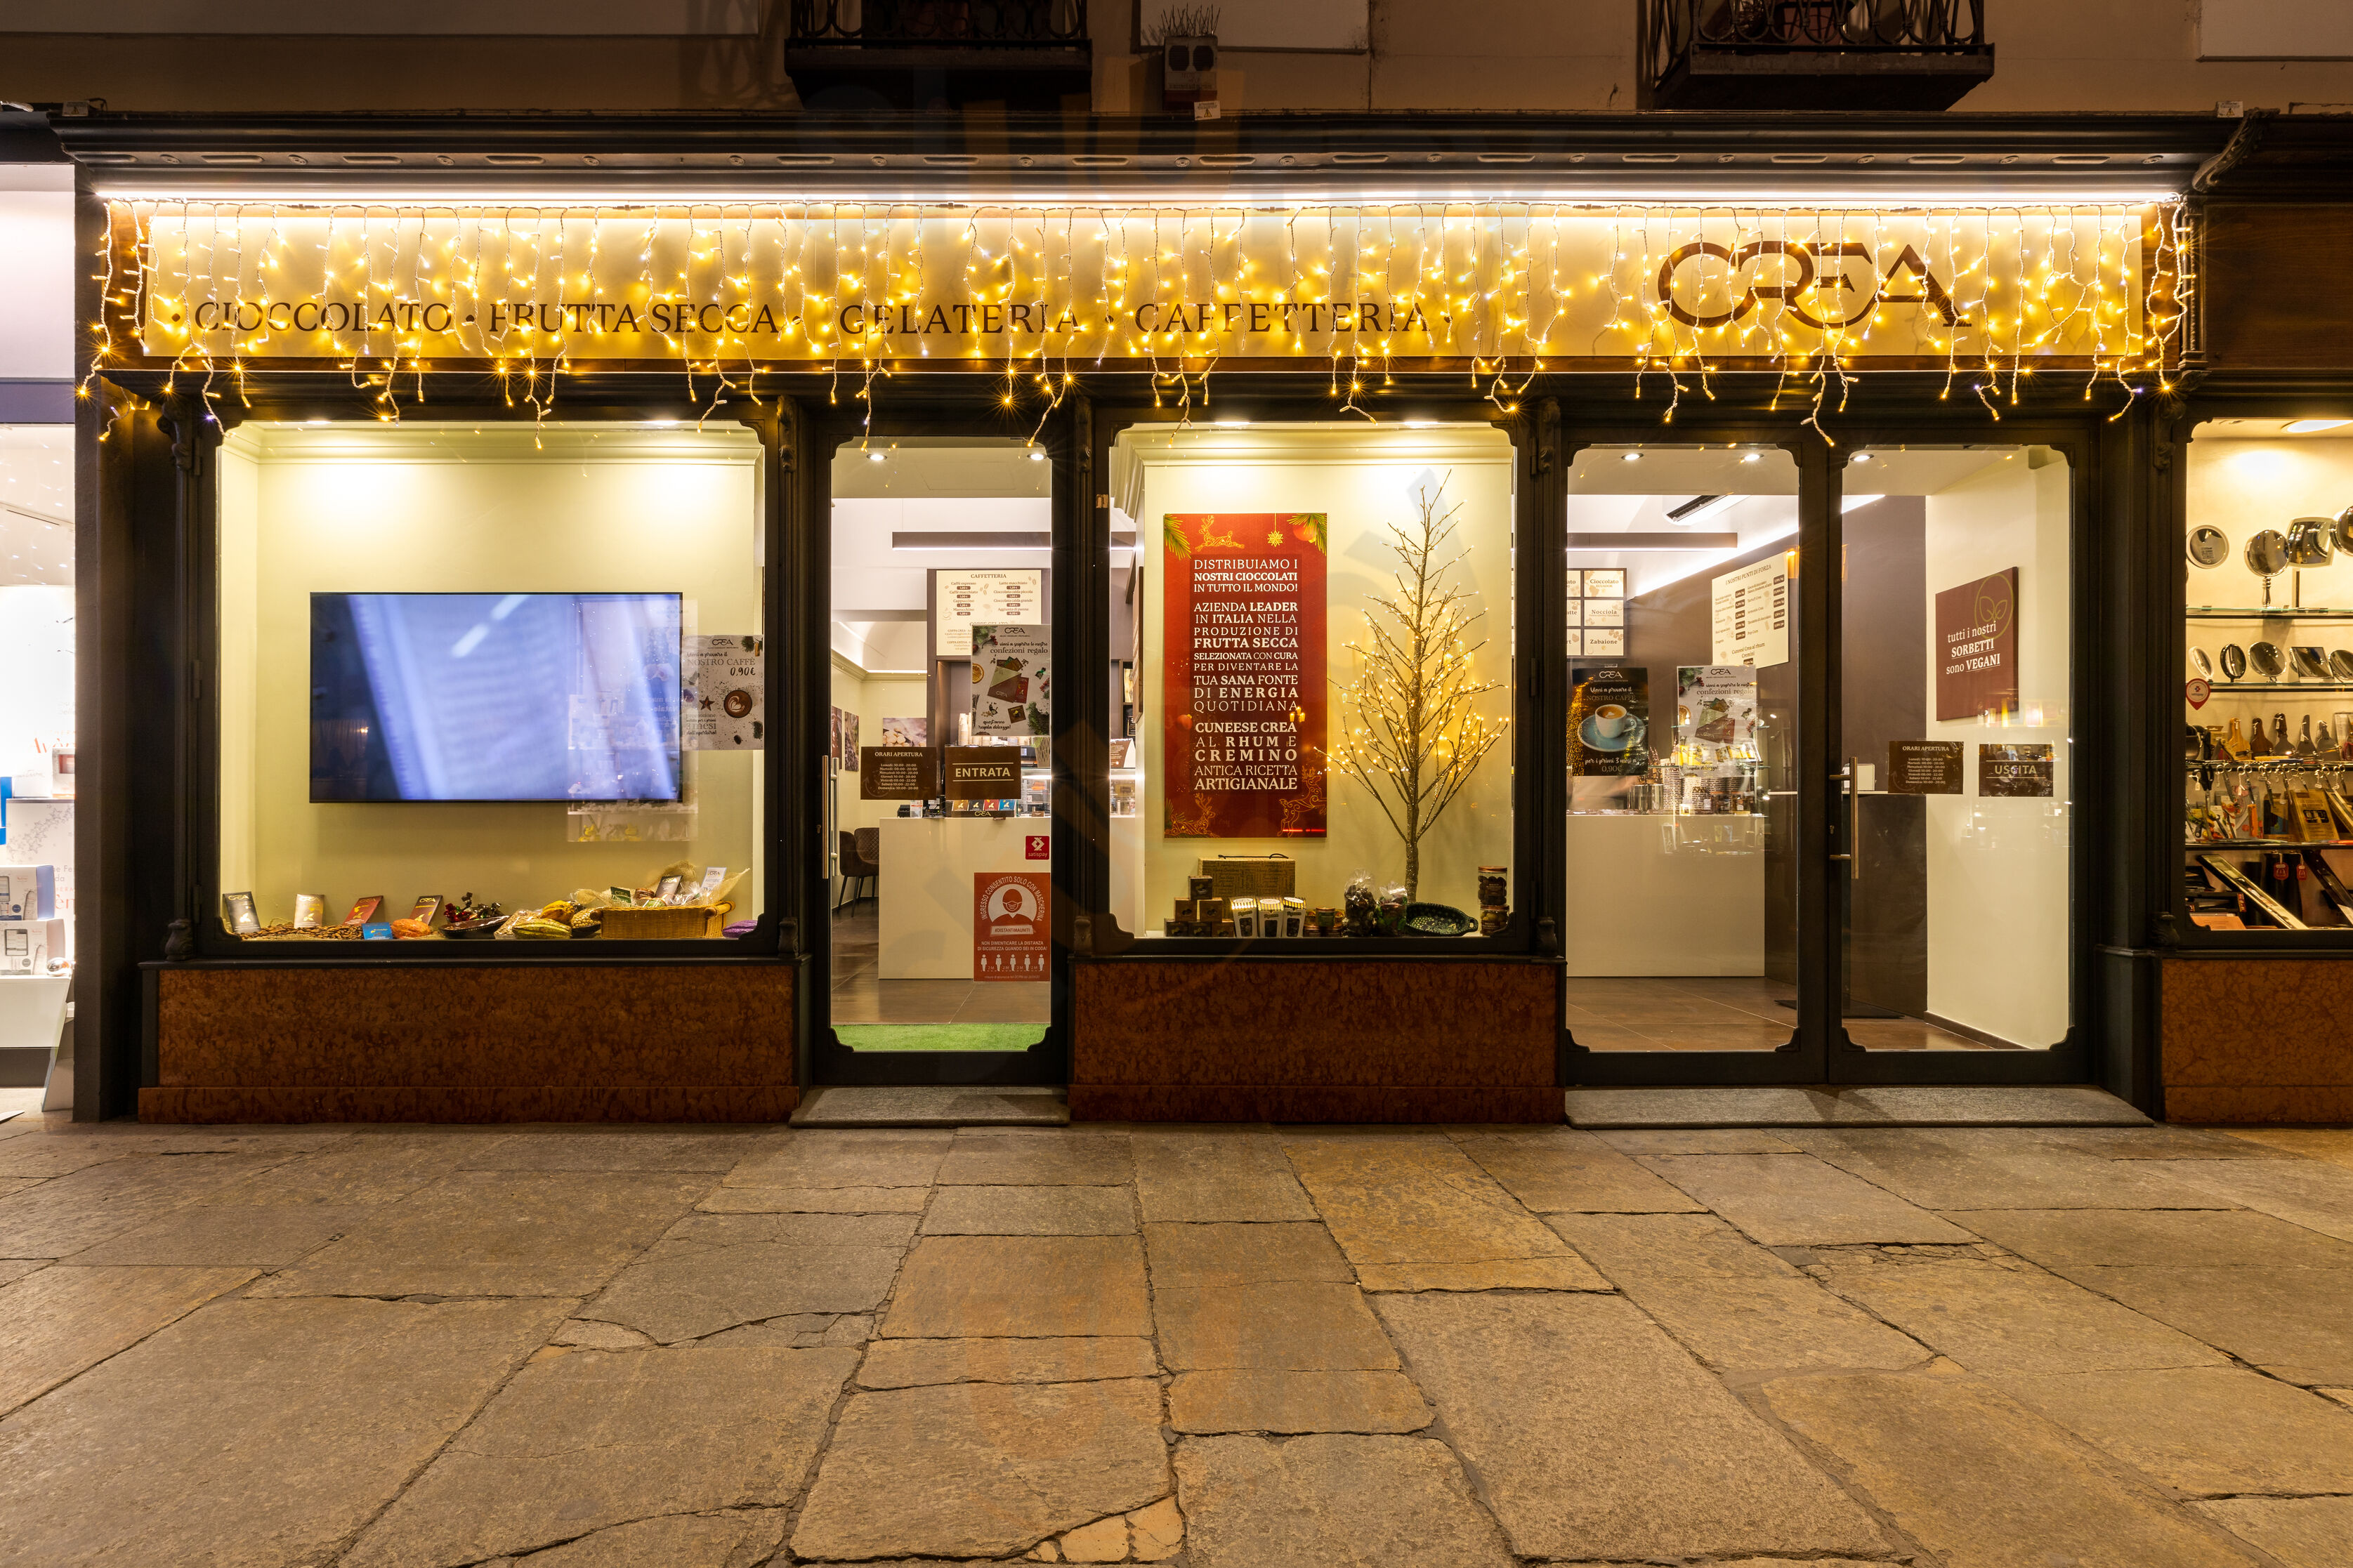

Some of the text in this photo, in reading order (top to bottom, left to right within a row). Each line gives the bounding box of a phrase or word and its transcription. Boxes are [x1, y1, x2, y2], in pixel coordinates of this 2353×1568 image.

[194, 301, 1432, 336] CIOCCOLATO FRUTTA SECCA GELATERIA CAFFETTERIA
[1194, 559, 1298, 569] DISTRIBUIAMO I
[1758, 564, 1771, 574] FORZA
[1194, 573, 1297, 581] NOSTRI CIOCCOLATI
[1194, 584, 1298, 593] IN TUTTO IL MONDO!
[1194, 602, 1298, 612] AZIENDA LEADER
[1195, 614, 1297, 624] IN ITALIA NELLA
[1194, 627, 1298, 636] PRODUZIONE DI
[1947, 621, 1997, 644] tutti i nostri
[1194, 638, 1299, 649] FRUTTA SECCA
[1951, 638, 1995, 659] SORBETTI
[727, 657, 756, 666] CAFFÈ
[1946, 653, 2000, 675] sono VEGANI
[730, 667, 756, 676] 0,90€
[1194, 663, 1299, 671] PER DIVENTARE LA
[1194, 675, 1298, 685] TUA SANA FONTE
[1194, 687, 1299, 698] DI ENERGIA
[1194, 701, 1297, 713] QUOTIDIANA
[1195, 723, 1297, 733] CUNEESE CREA
[1195, 736, 1297, 747] AL RHUM E
[1195, 749, 1297, 762] CREMINO
[955, 767, 1011, 777] ENTRATA
[1194, 765, 1298, 776] ANTICA RICETTA
[1994, 765, 2037, 775] USCITA
[1194, 778, 1297, 790] ARTIGIANALE
[985, 876, 1013, 895] CONSENTITO
[1014, 876, 1028, 885] SOLO
[1027, 881, 1037, 892] CON
[1035, 890, 1045, 921] MASCHERINA
